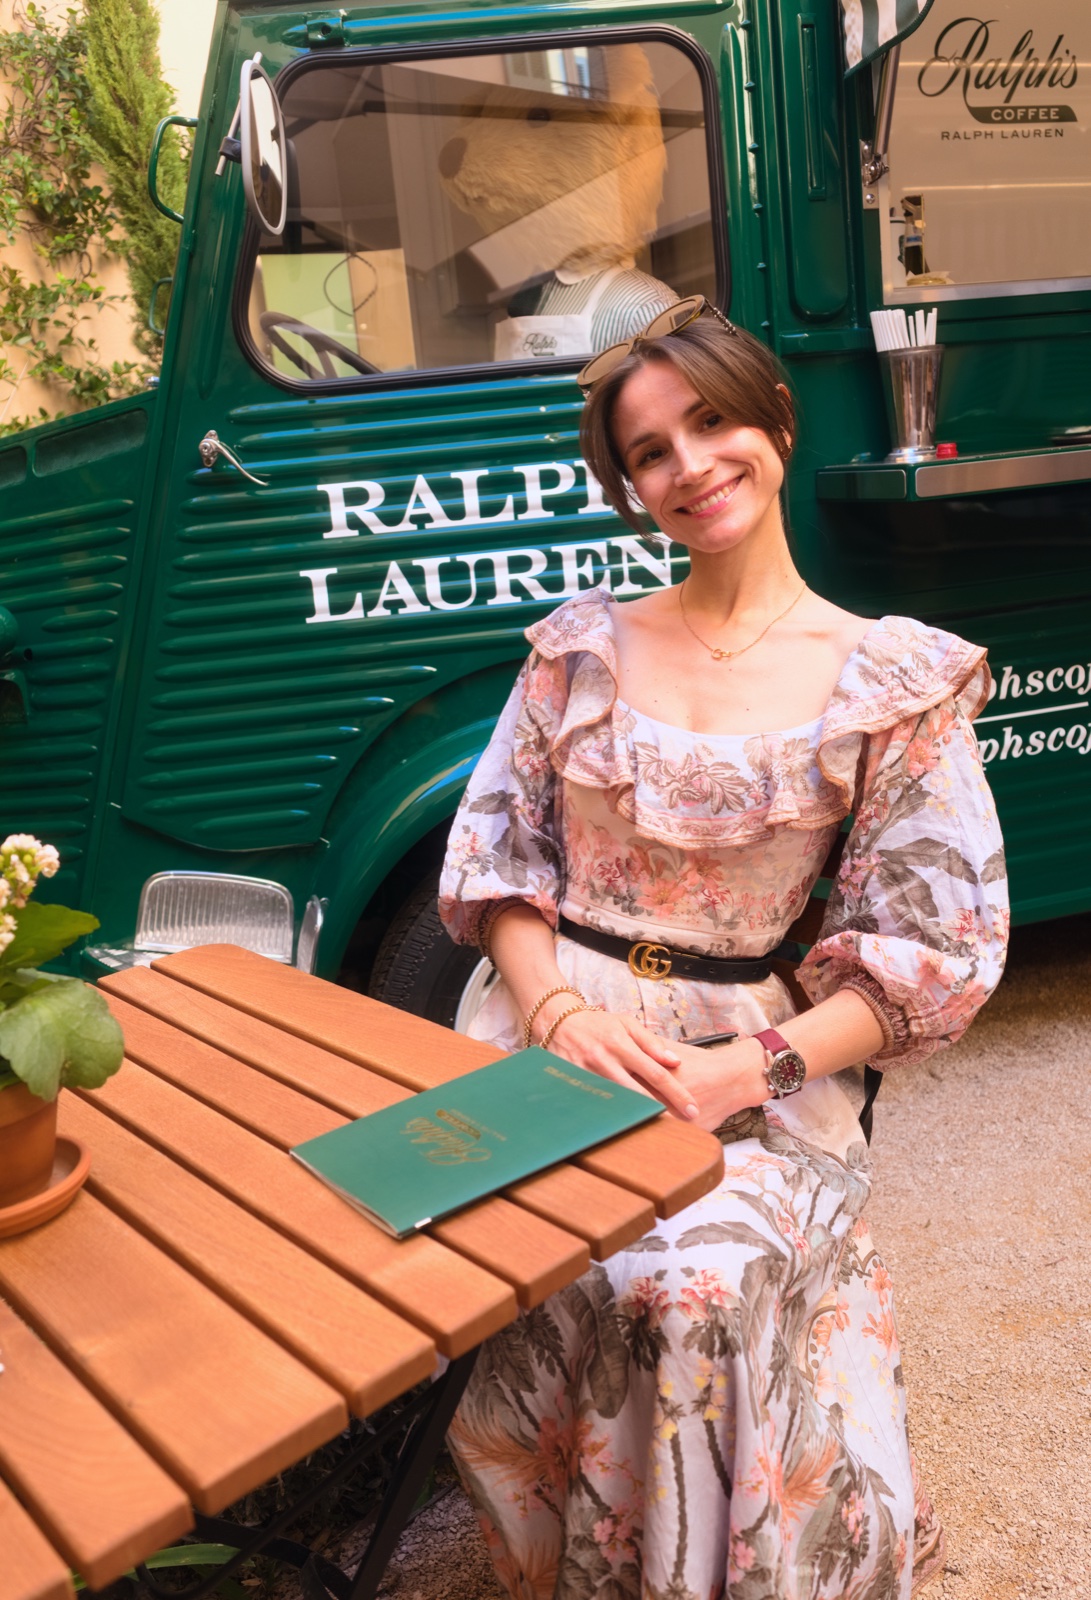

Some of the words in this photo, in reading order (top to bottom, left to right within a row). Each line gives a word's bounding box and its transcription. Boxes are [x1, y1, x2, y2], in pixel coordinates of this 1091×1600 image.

[917, 17, 1078, 105] Ralph's
[941, 130, 994, 141] RALPH
[1001, 128, 1064, 139] LAUREN
[991, 108, 1060, 121] COFFEE
[299, 537, 675, 624] LAUREN
